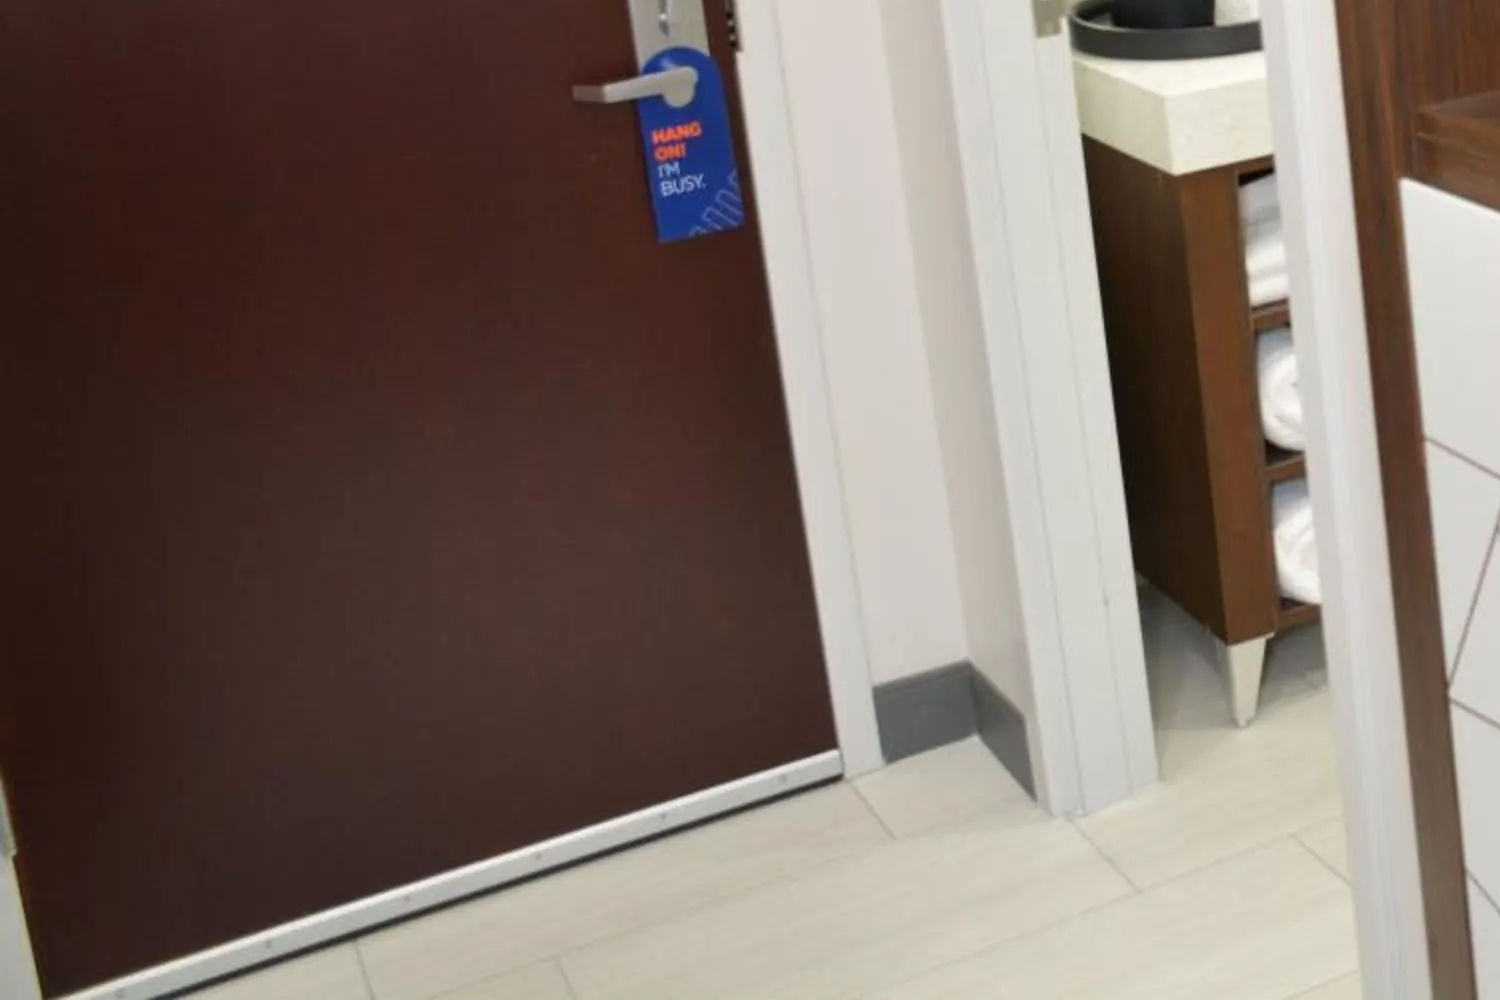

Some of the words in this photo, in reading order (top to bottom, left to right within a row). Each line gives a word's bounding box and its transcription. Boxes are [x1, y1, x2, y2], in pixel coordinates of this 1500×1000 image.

[652, 122, 701, 144] HANG
[655, 142, 686, 161] ON!
[658, 161, 680, 177] I'M
